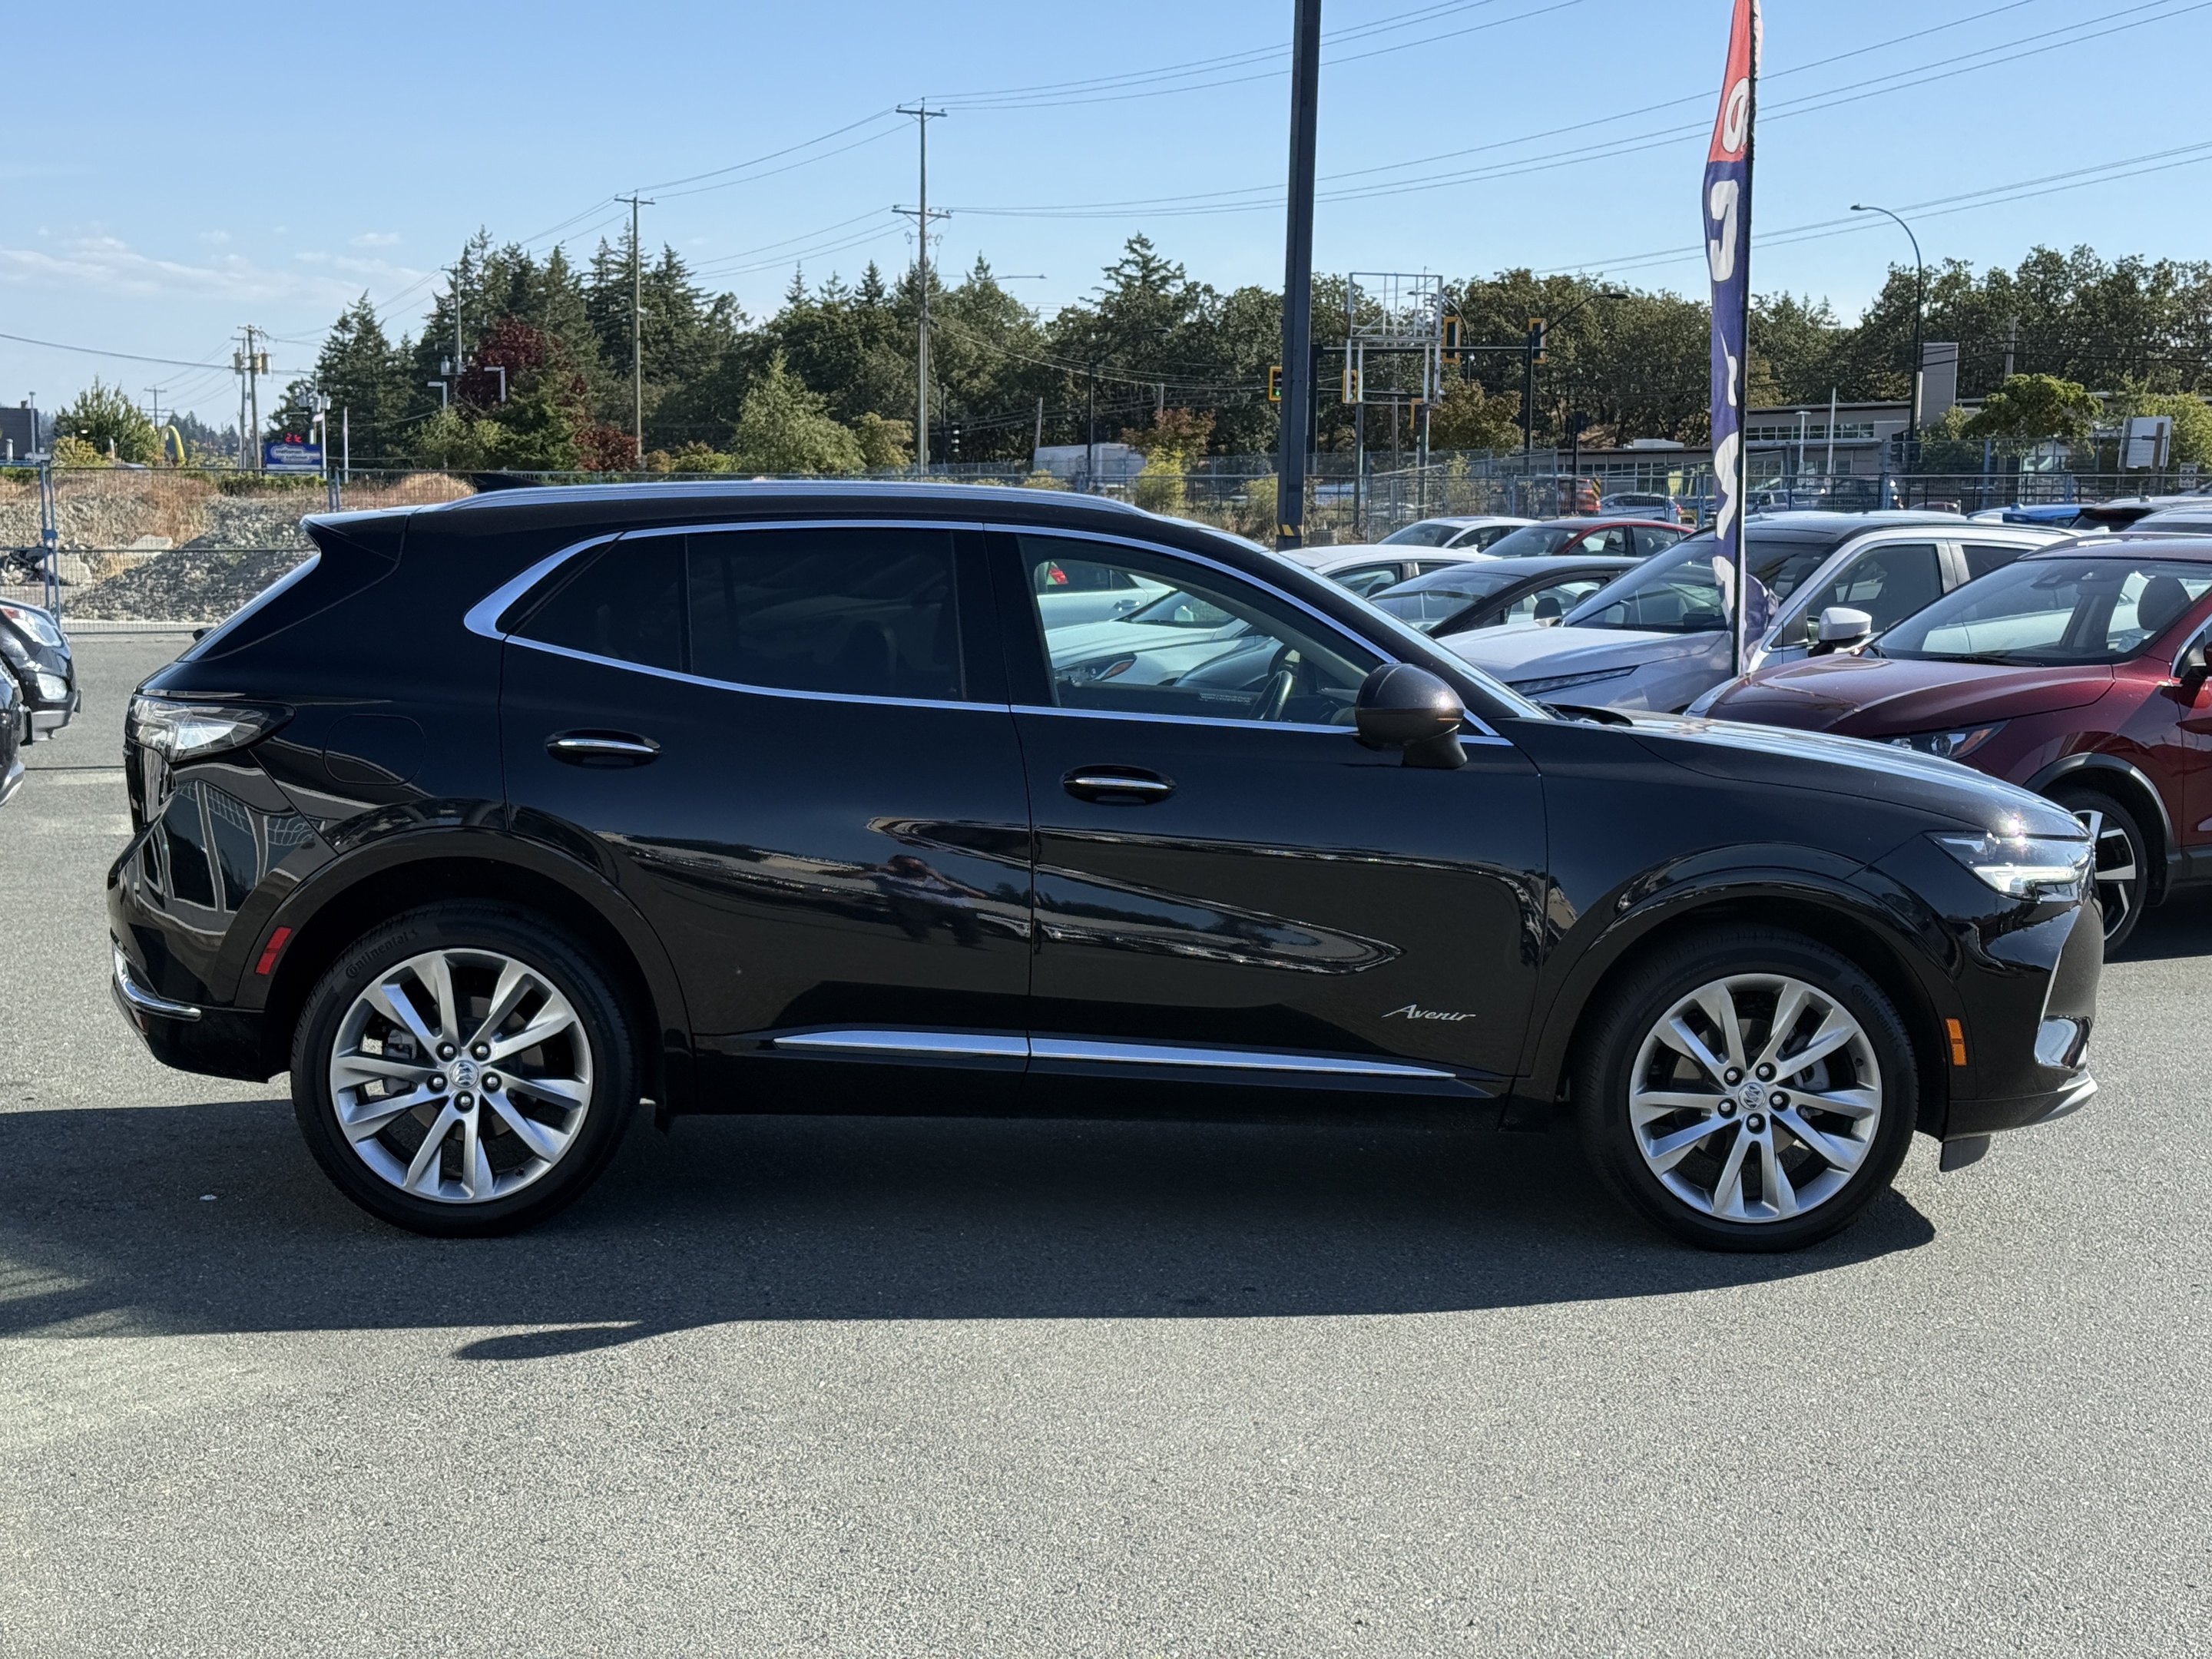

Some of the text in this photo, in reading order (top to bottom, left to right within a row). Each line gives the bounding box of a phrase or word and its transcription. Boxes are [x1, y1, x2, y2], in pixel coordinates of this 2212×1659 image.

[346, 931, 409, 979] Continental
[1381, 1004, 1476, 1022] Avenir
[1851, 984, 1899, 1043] Continental
